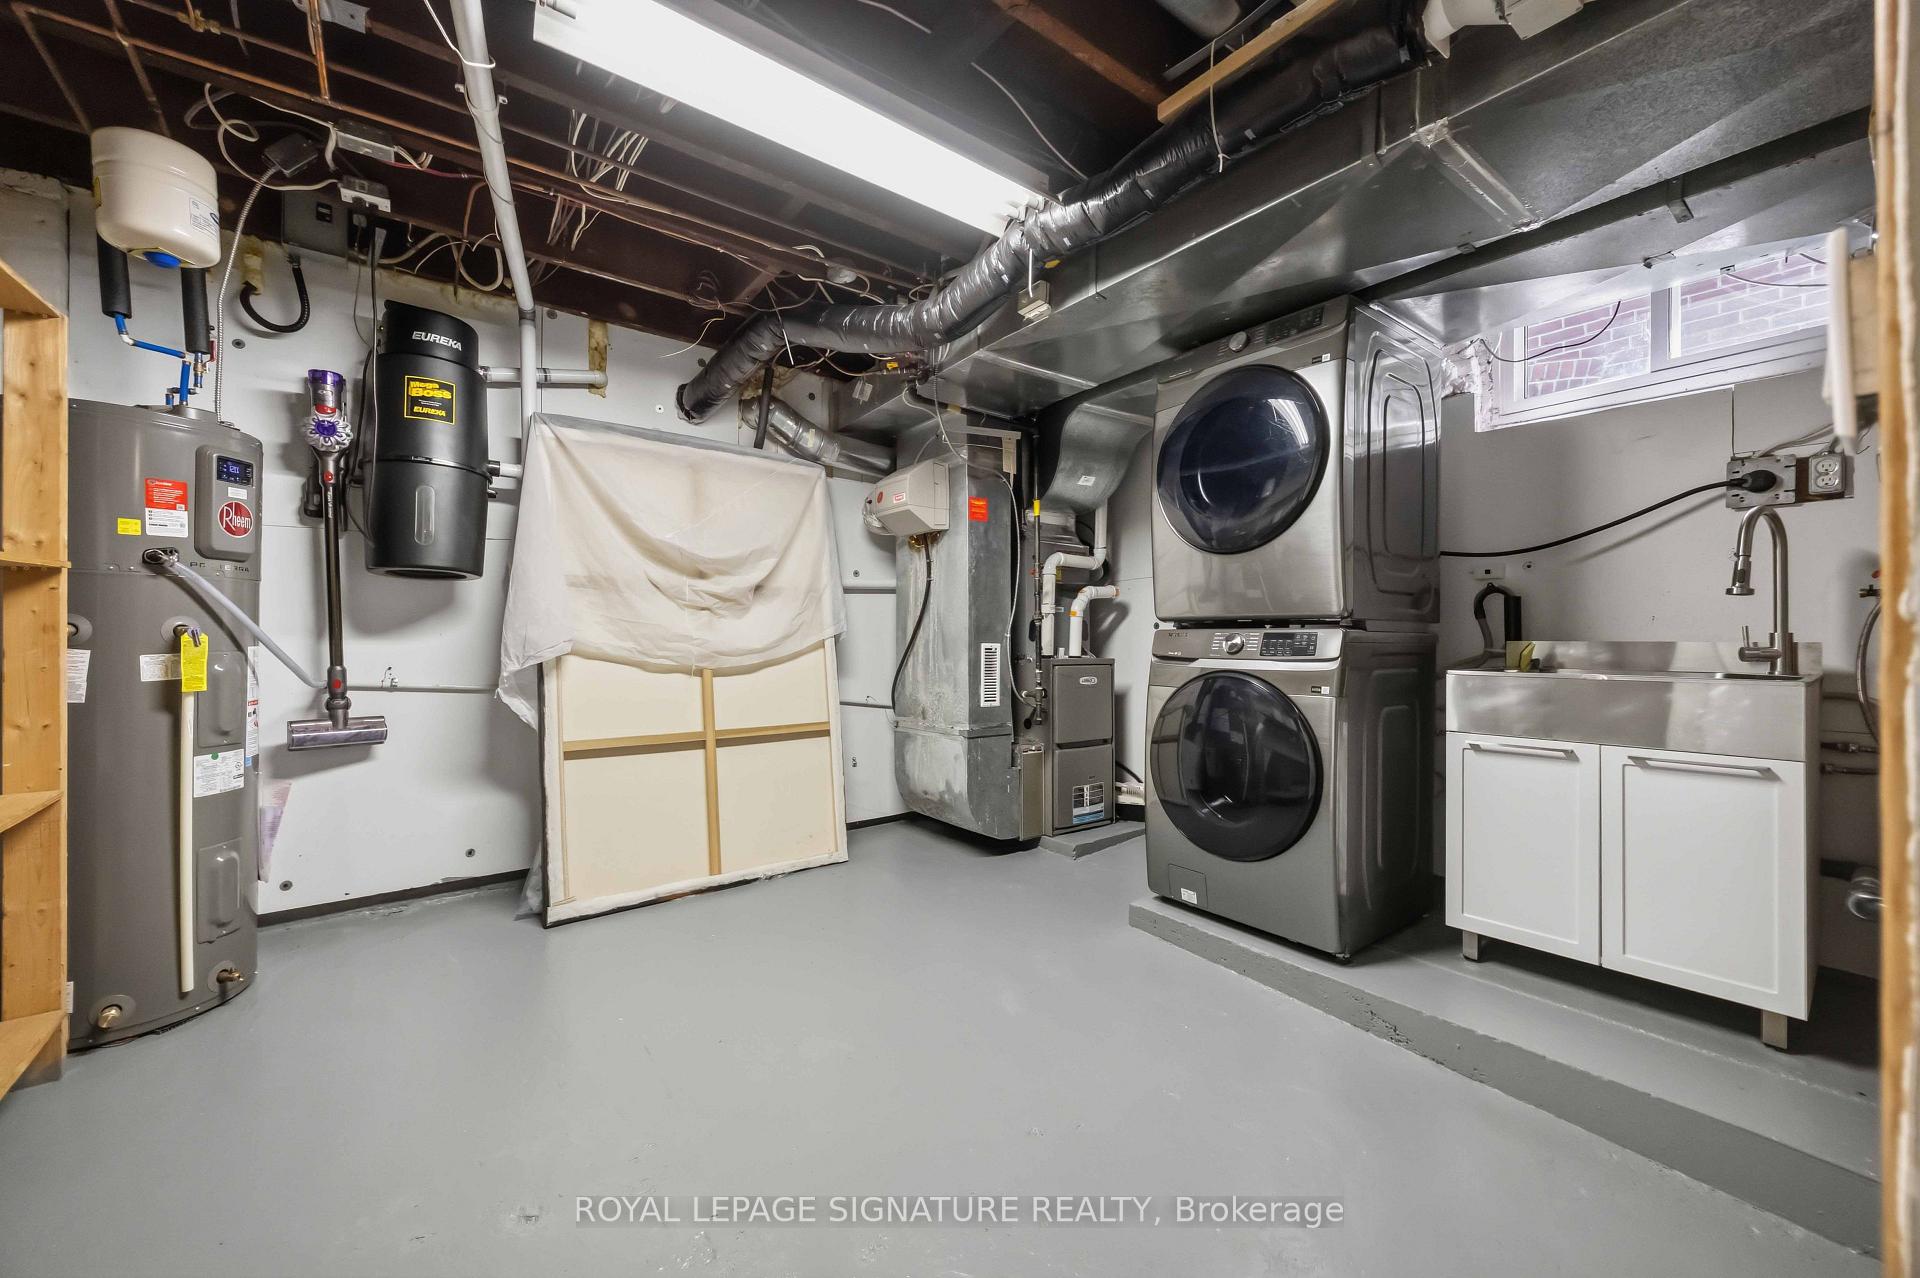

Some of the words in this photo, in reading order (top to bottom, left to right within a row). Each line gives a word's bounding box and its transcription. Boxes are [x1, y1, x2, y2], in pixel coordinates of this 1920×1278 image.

[412, 331, 462, 351] EUREKA
[413, 406, 446, 417] EUREKA
[223, 502, 251, 531] Rheem
